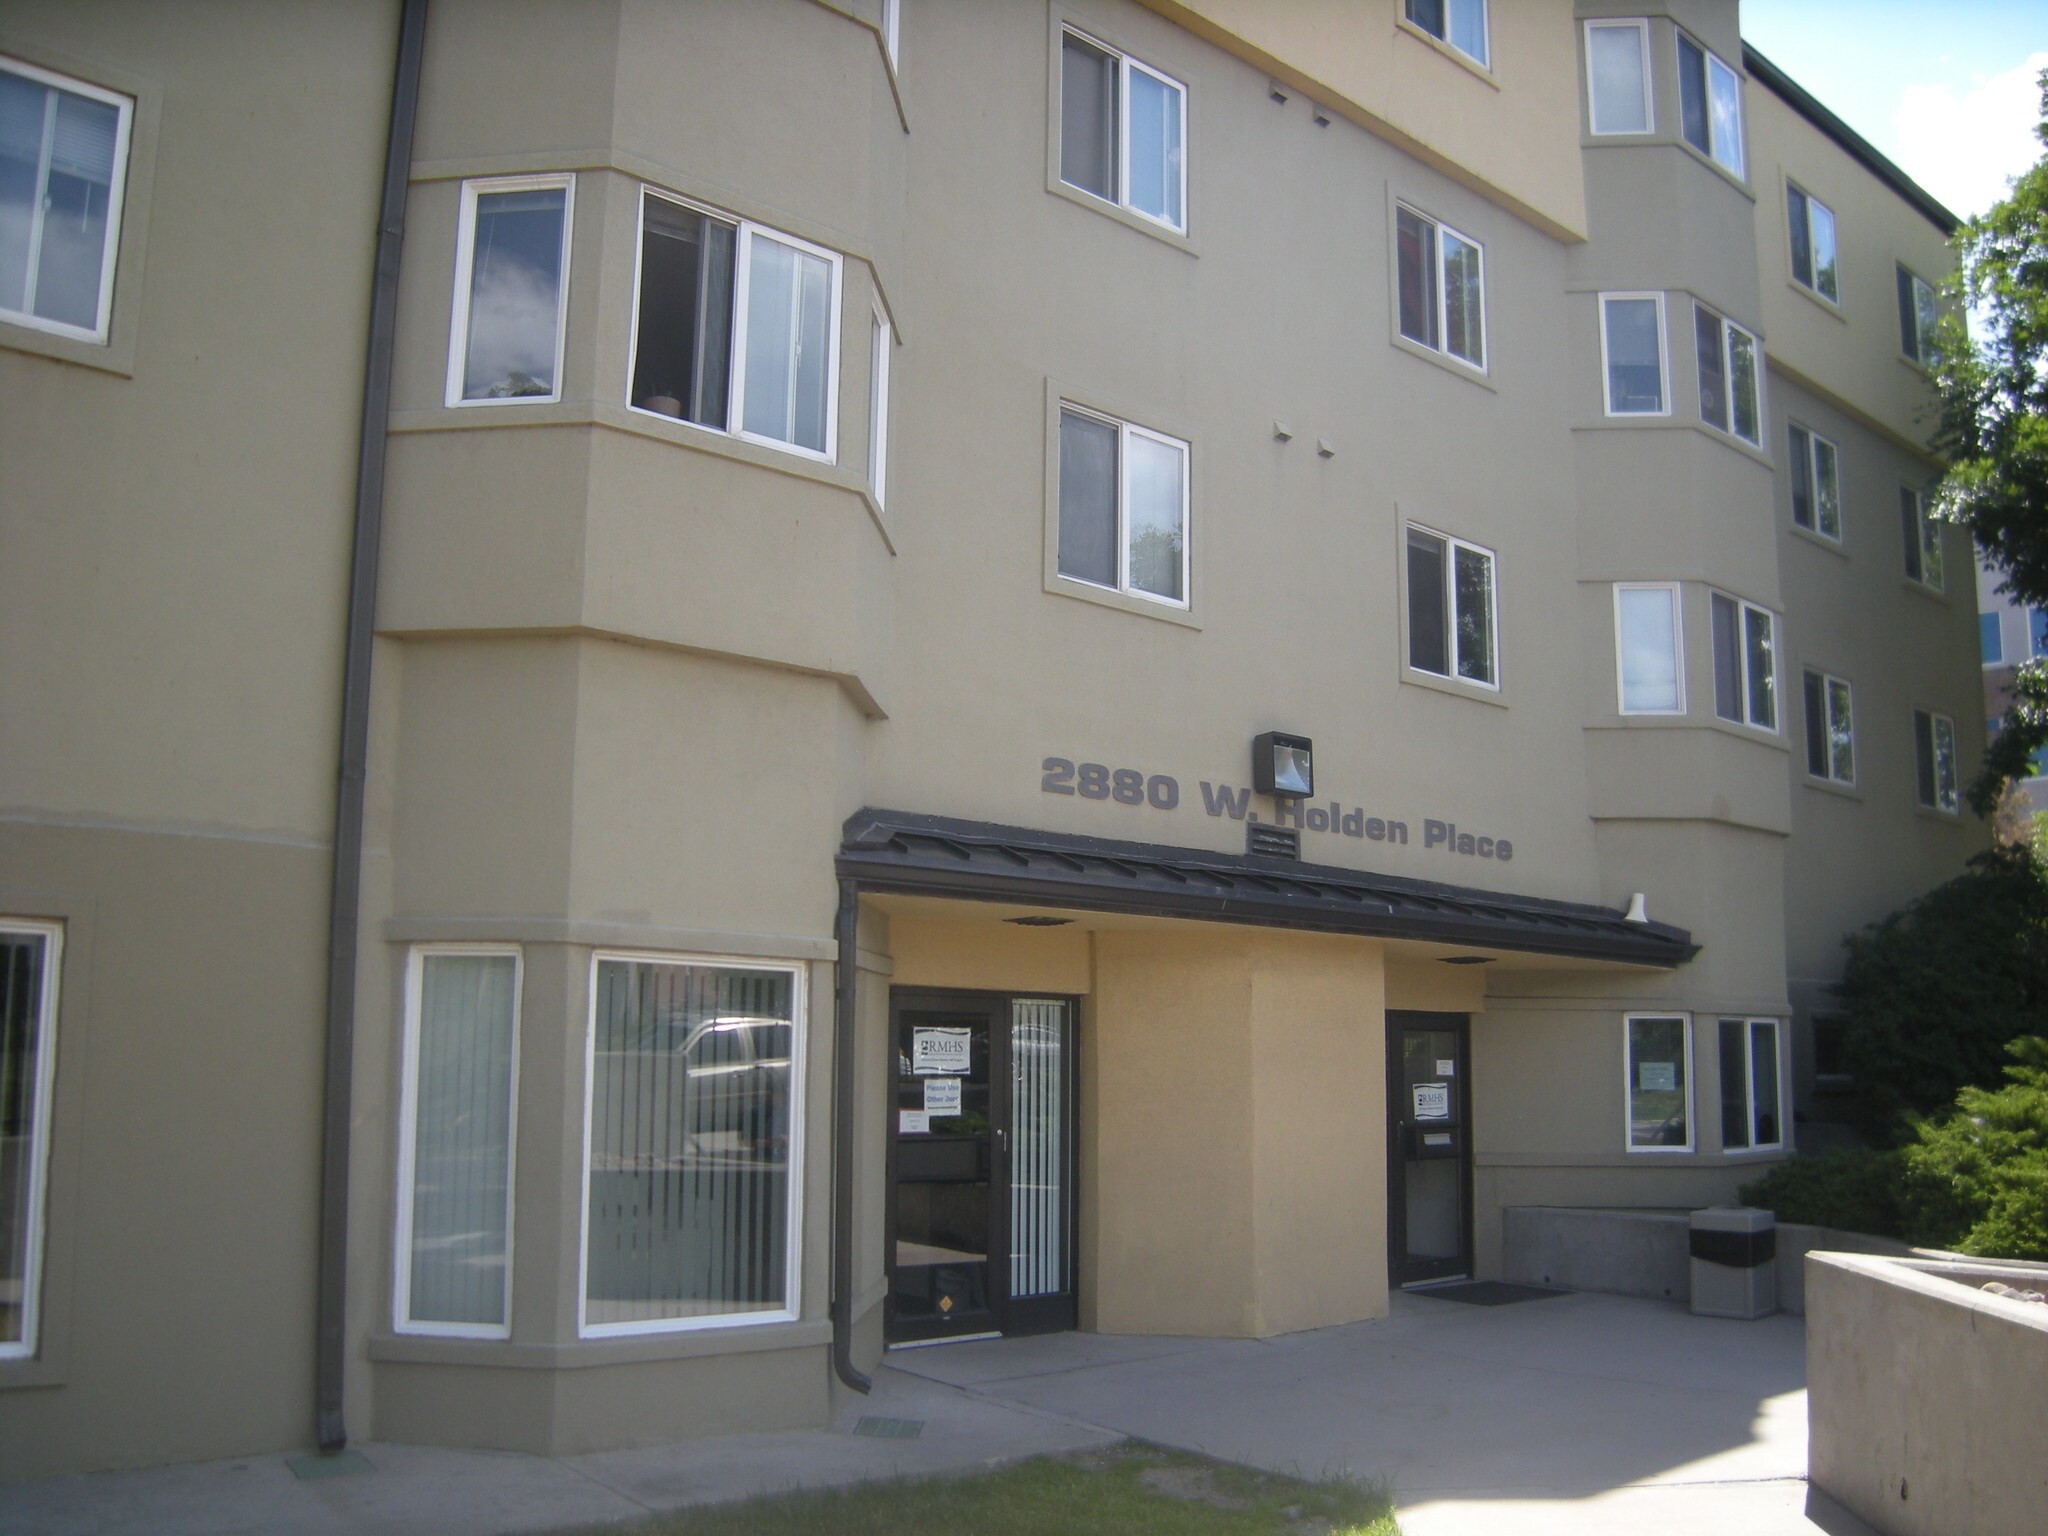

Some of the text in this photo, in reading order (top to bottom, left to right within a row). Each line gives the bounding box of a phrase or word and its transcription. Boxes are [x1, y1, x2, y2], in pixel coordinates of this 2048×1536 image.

[1041, 756, 1514, 862] 2880 W. Holden Place
[929, 1040, 963, 1052] RMHS
[1422, 1093, 1444, 1102] RMHS
